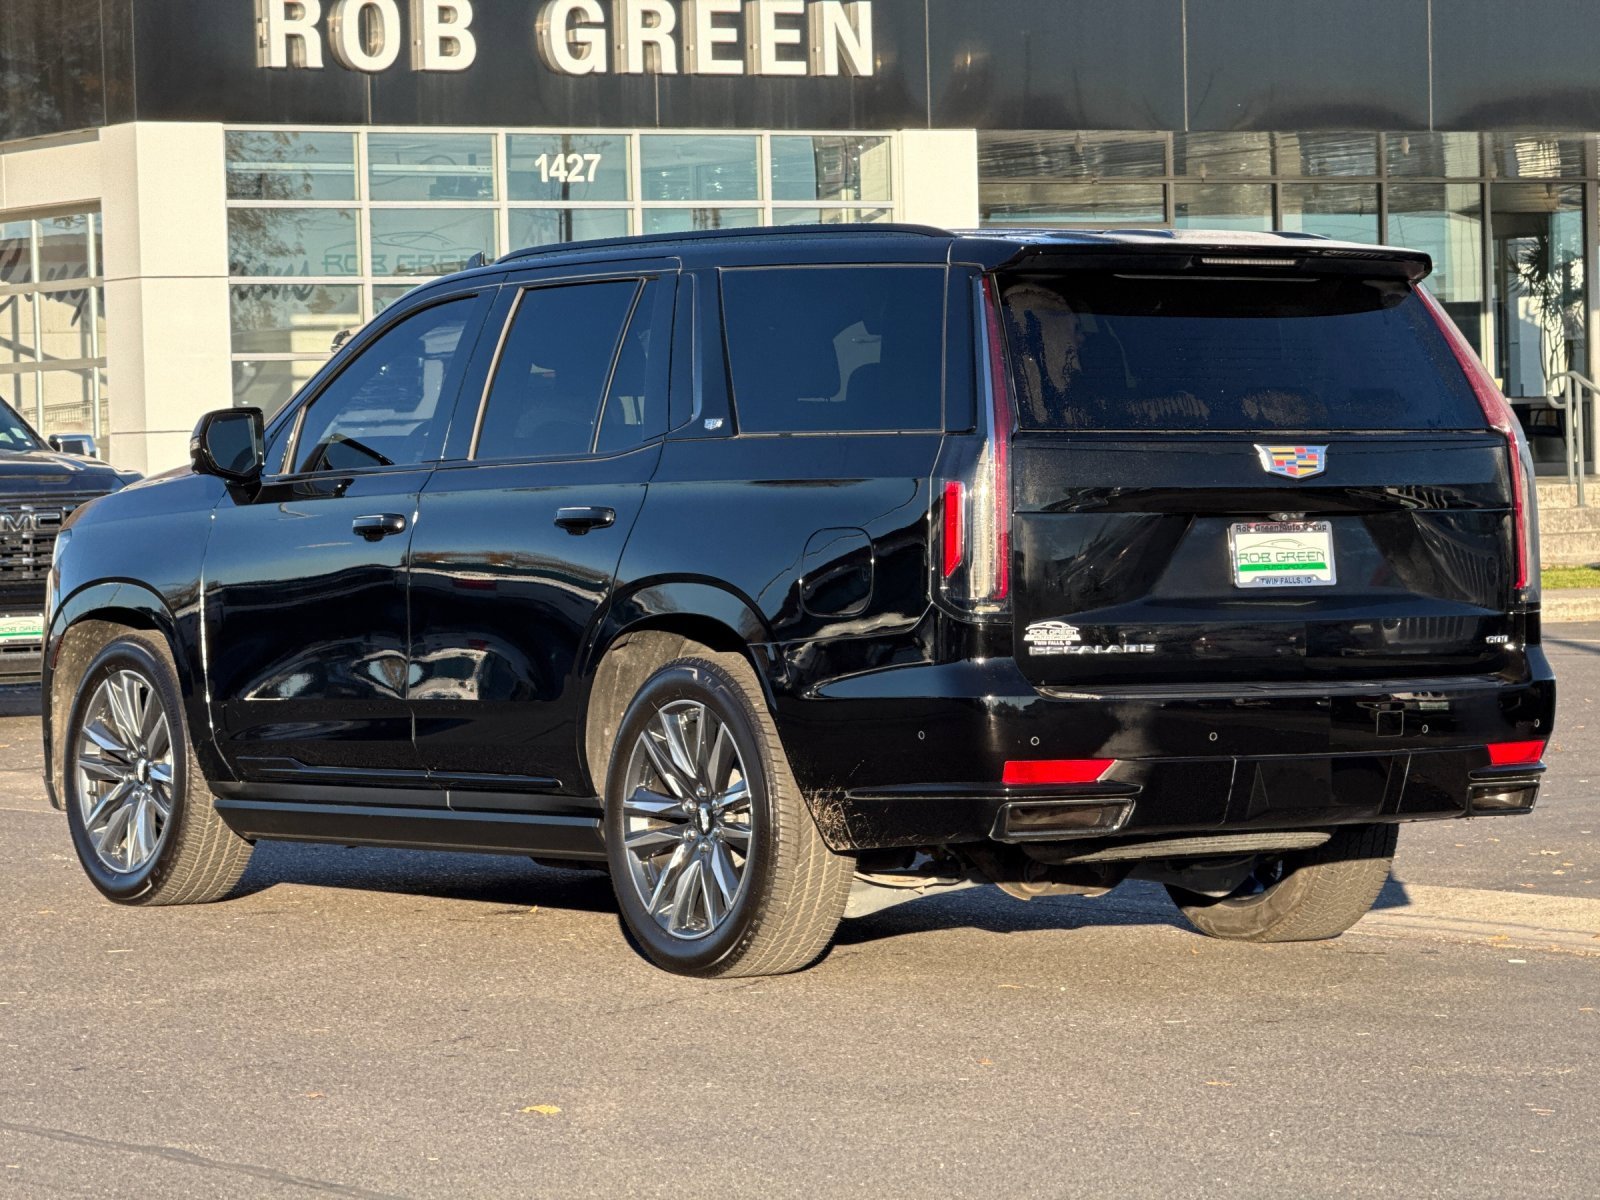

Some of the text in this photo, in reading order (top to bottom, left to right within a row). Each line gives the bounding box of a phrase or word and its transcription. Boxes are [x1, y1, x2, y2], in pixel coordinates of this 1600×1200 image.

[255, 0, 874, 76] ROB GREEN
[534, 153, 602, 182] 1427
[0, 513, 60, 531] MC
[1255, 524, 1279, 532] Green
[1283, 523, 1301, 531] Auto
[1236, 551, 1326, 563] ROB GREEN
[1260, 577, 1279, 585] TWIN
[1304, 576, 1312, 584] ID
